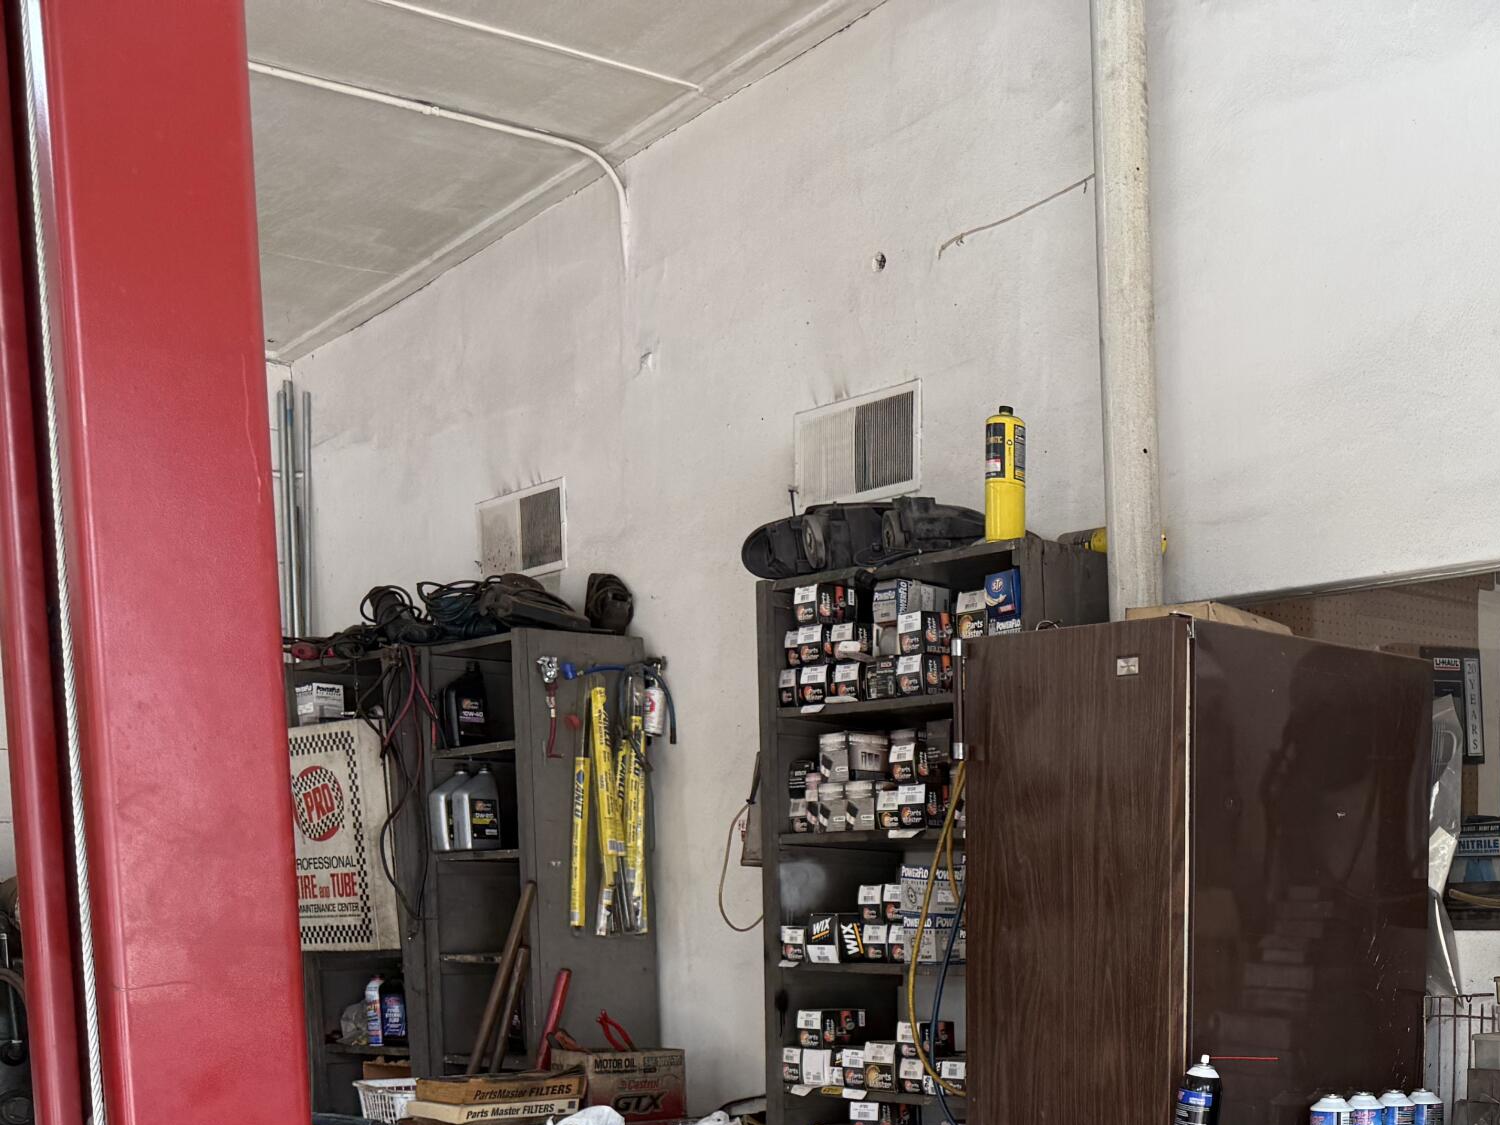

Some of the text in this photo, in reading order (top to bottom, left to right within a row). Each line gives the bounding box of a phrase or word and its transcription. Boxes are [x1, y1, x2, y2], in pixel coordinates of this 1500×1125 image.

[966, 623, 984, 632] Parts
[304, 783, 336, 823] PRO
[1460, 838, 1499, 850] NITRILE
[297, 855, 357, 871] ROFESSIONAL
[330, 871, 359, 898] TUBE
[337, 902, 360, 912] CENTER
[812, 917, 831, 936] WIX
[841, 922, 858, 956] WIX
[594, 1058, 622, 1070] MOTOR
[624, 1057, 637, 1069] OIL
[529, 1083, 573, 1097] FILTERS
[614, 1090, 666, 1114] GTX
[466, 1103, 555, 1120] Parts Master FILTERS
